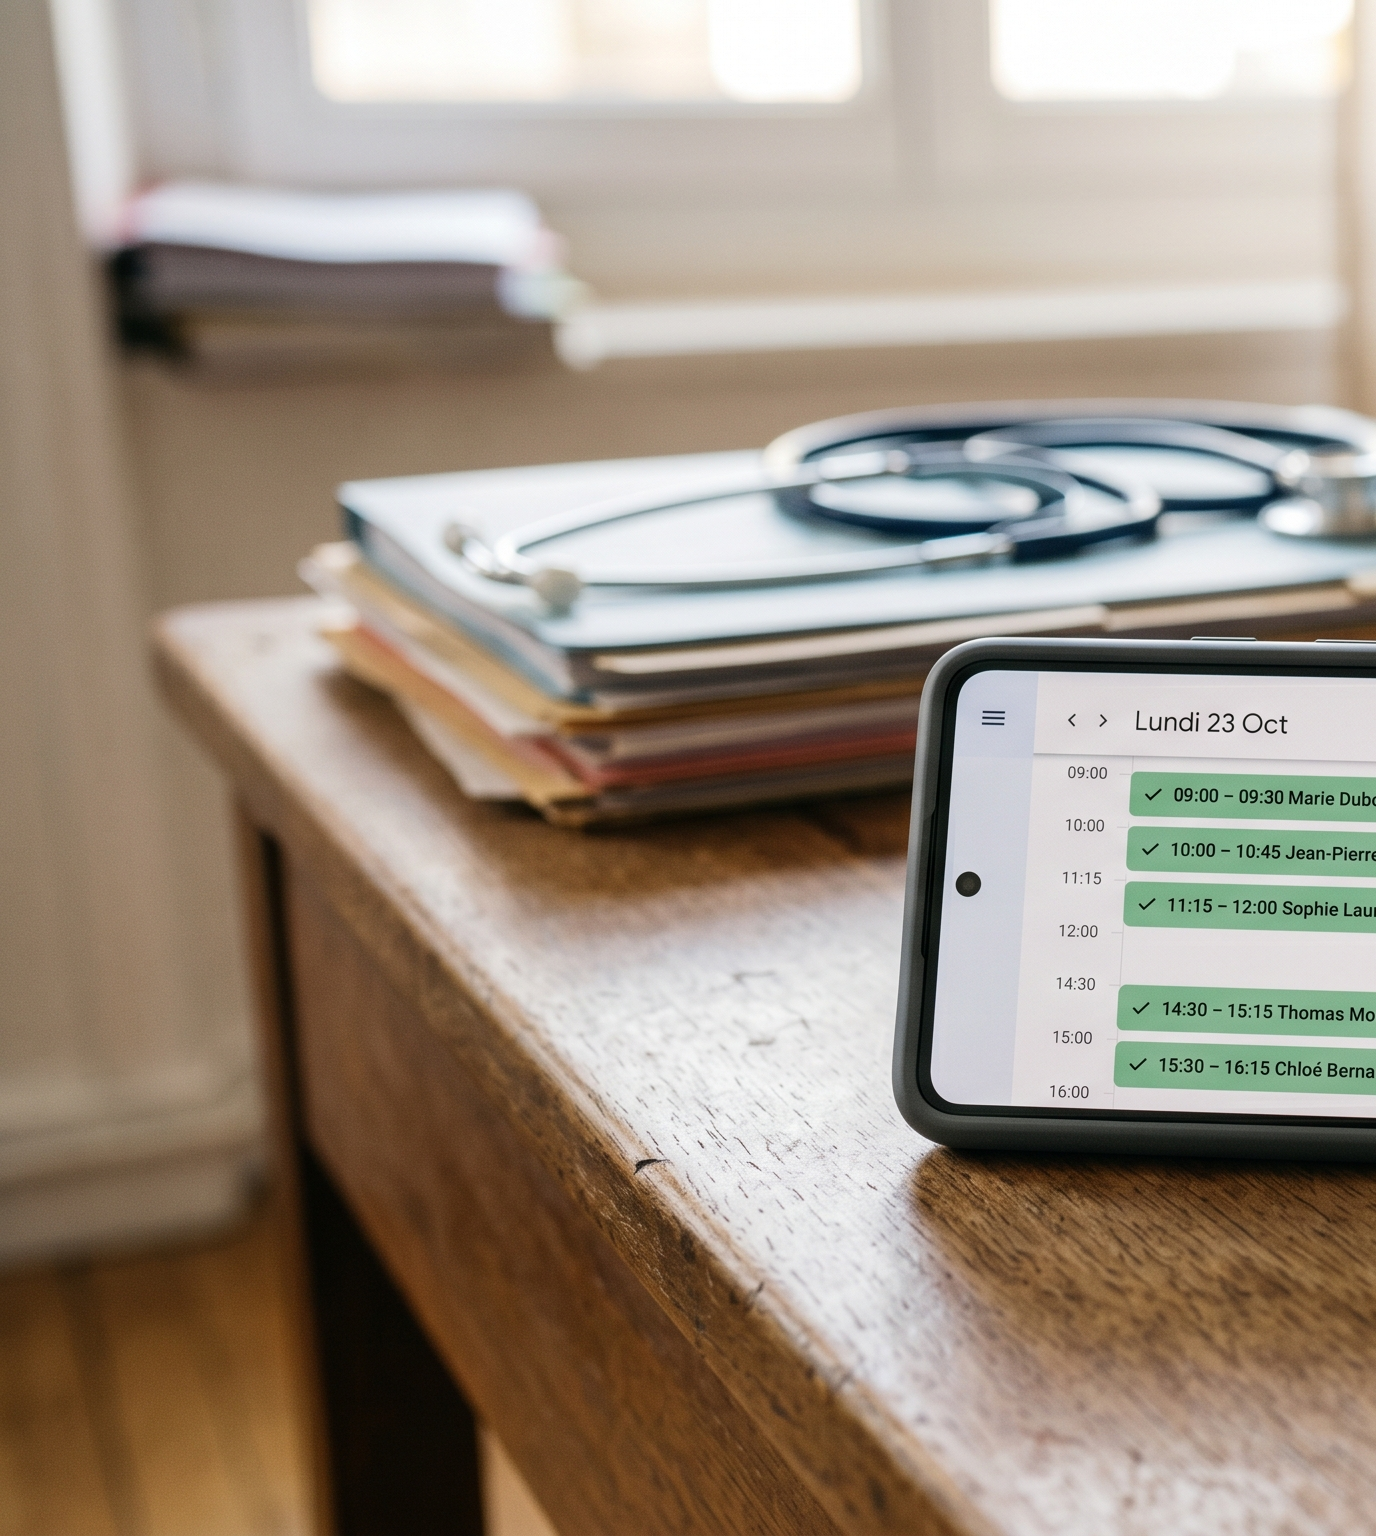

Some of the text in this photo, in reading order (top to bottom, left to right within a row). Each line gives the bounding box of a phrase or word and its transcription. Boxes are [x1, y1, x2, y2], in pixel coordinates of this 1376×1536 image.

[1135, 709, 1289, 735] Lundi 23 Oct
[1067, 765, 1108, 780] 09:00
[1173, 787, 1219, 804] 09:00
[1238, 788, 1284, 805] 09:30
[1288, 790, 1335, 806] Marie
[1065, 818, 1105, 833] 10:00
[1171, 842, 1216, 858] 10:00
[1236, 843, 1281, 860] 10:45
[1062, 871, 1102, 886] 11:15
[1167, 897, 1213, 914] 11:15
[1232, 899, 1278, 916] 12:00
[1282, 900, 1339, 920] Sophie
[1059, 924, 1099, 939] 12:00
[1056, 976, 1096, 991] 14:30
[1162, 1001, 1208, 1017] 14:30
[1227, 1003, 1273, 1019] 15:15
[1277, 1004, 1345, 1022] Thomas
[1053, 1030, 1093, 1045] 15:00
[1159, 1057, 1205, 1074] 15:30
[1224, 1059, 1271, 1076] 16:15
[1274, 1060, 1323, 1078] Chloé
[1049, 1084, 1090, 1099] 16:00
